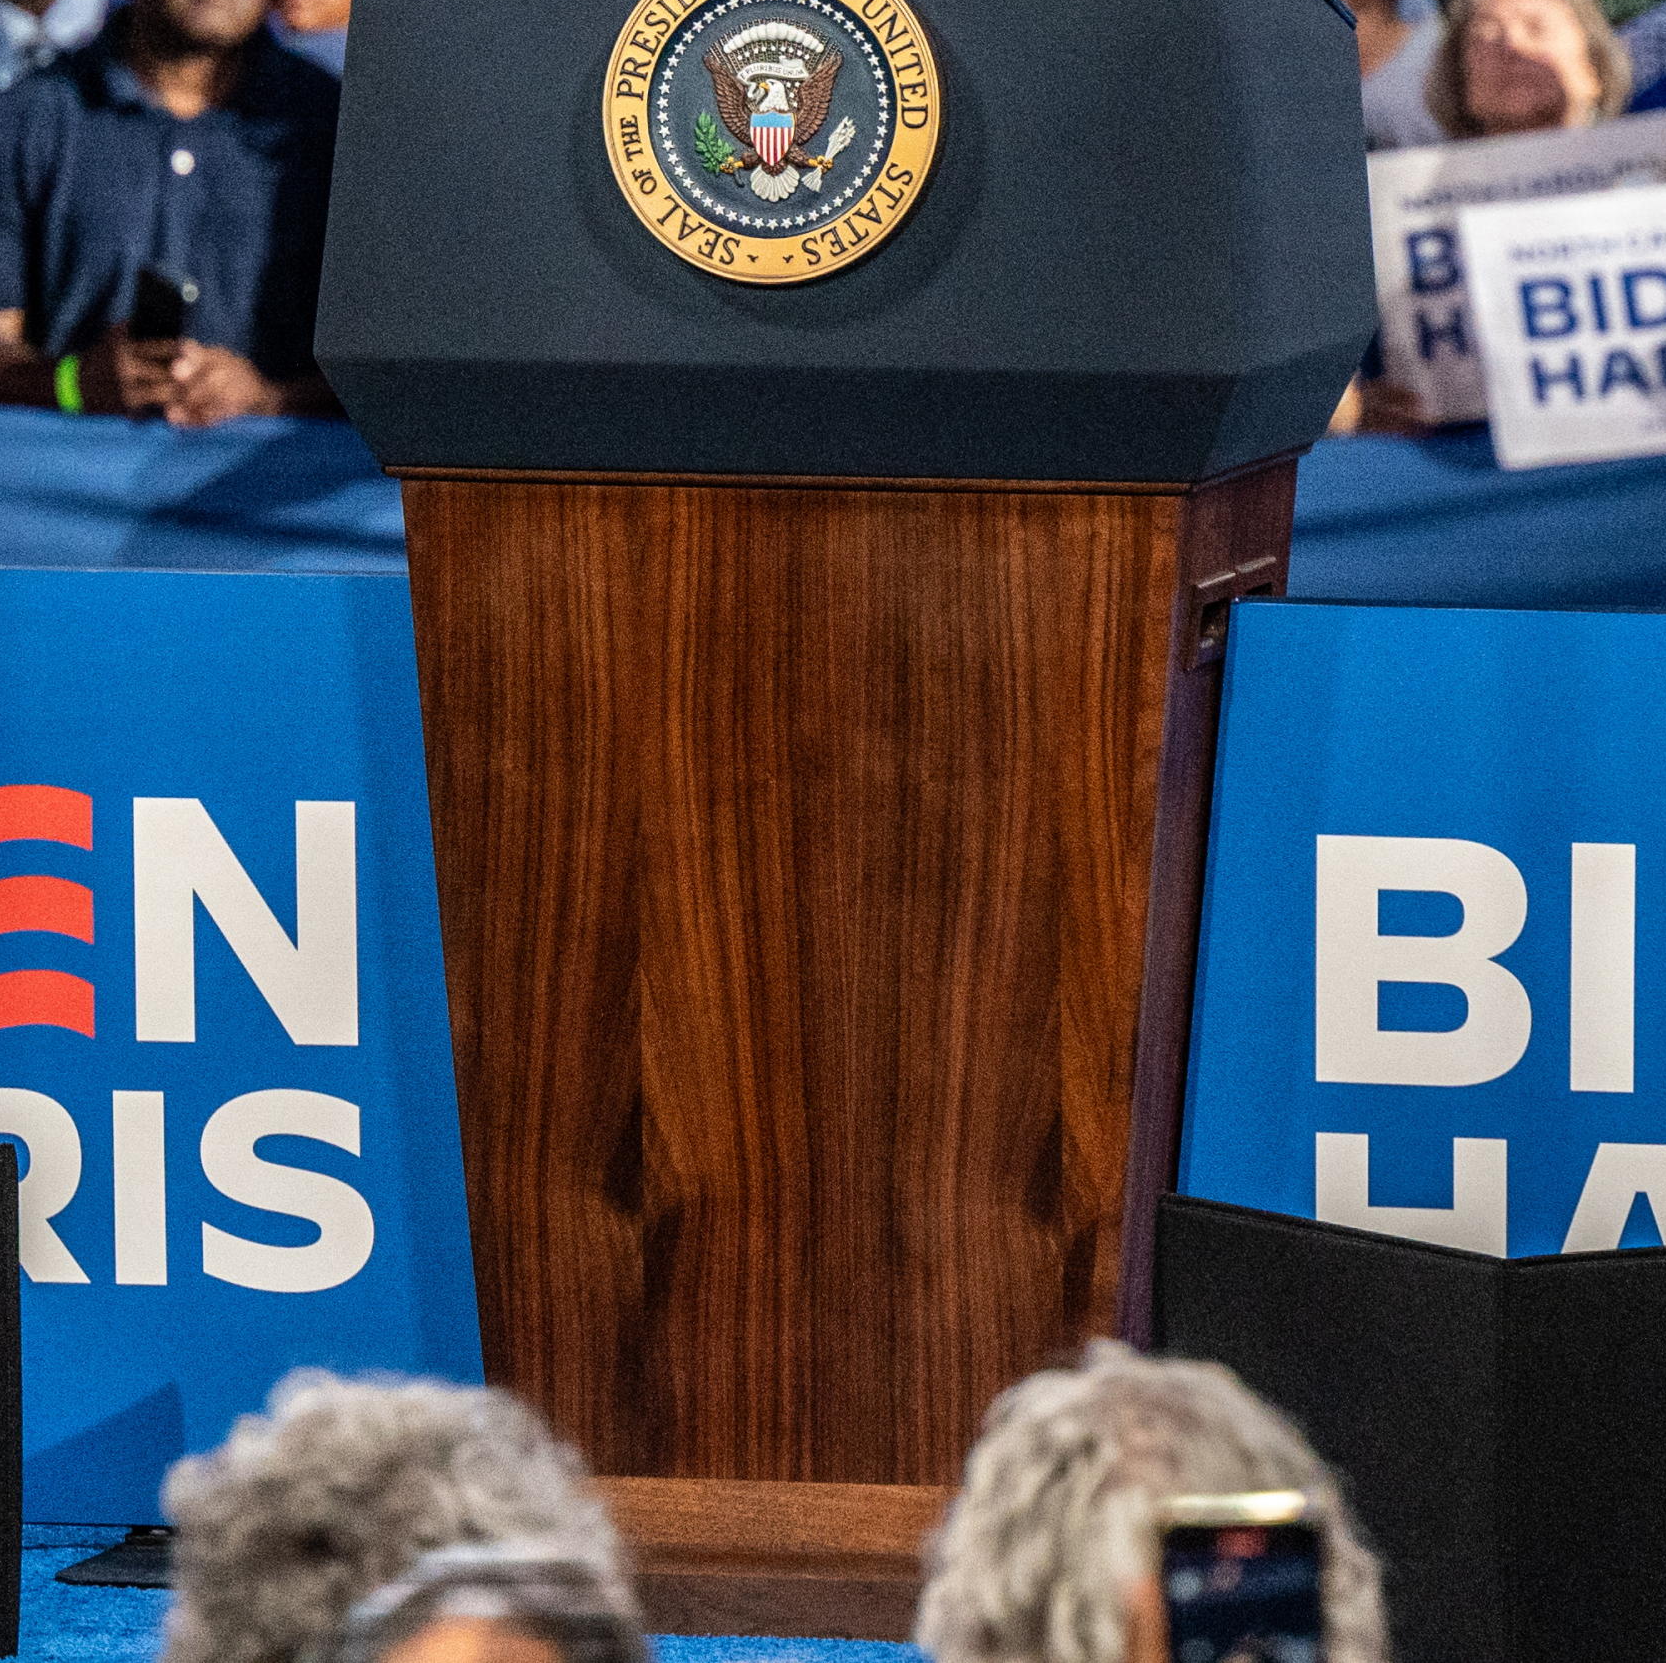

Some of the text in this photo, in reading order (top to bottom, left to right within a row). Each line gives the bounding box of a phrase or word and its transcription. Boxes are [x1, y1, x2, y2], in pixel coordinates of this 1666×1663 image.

[622, 114, 644, 162] THE
[633, 168, 658, 195] OF
[658, 194, 741, 265] SEAL
[806, 163, 915, 267] STATES
